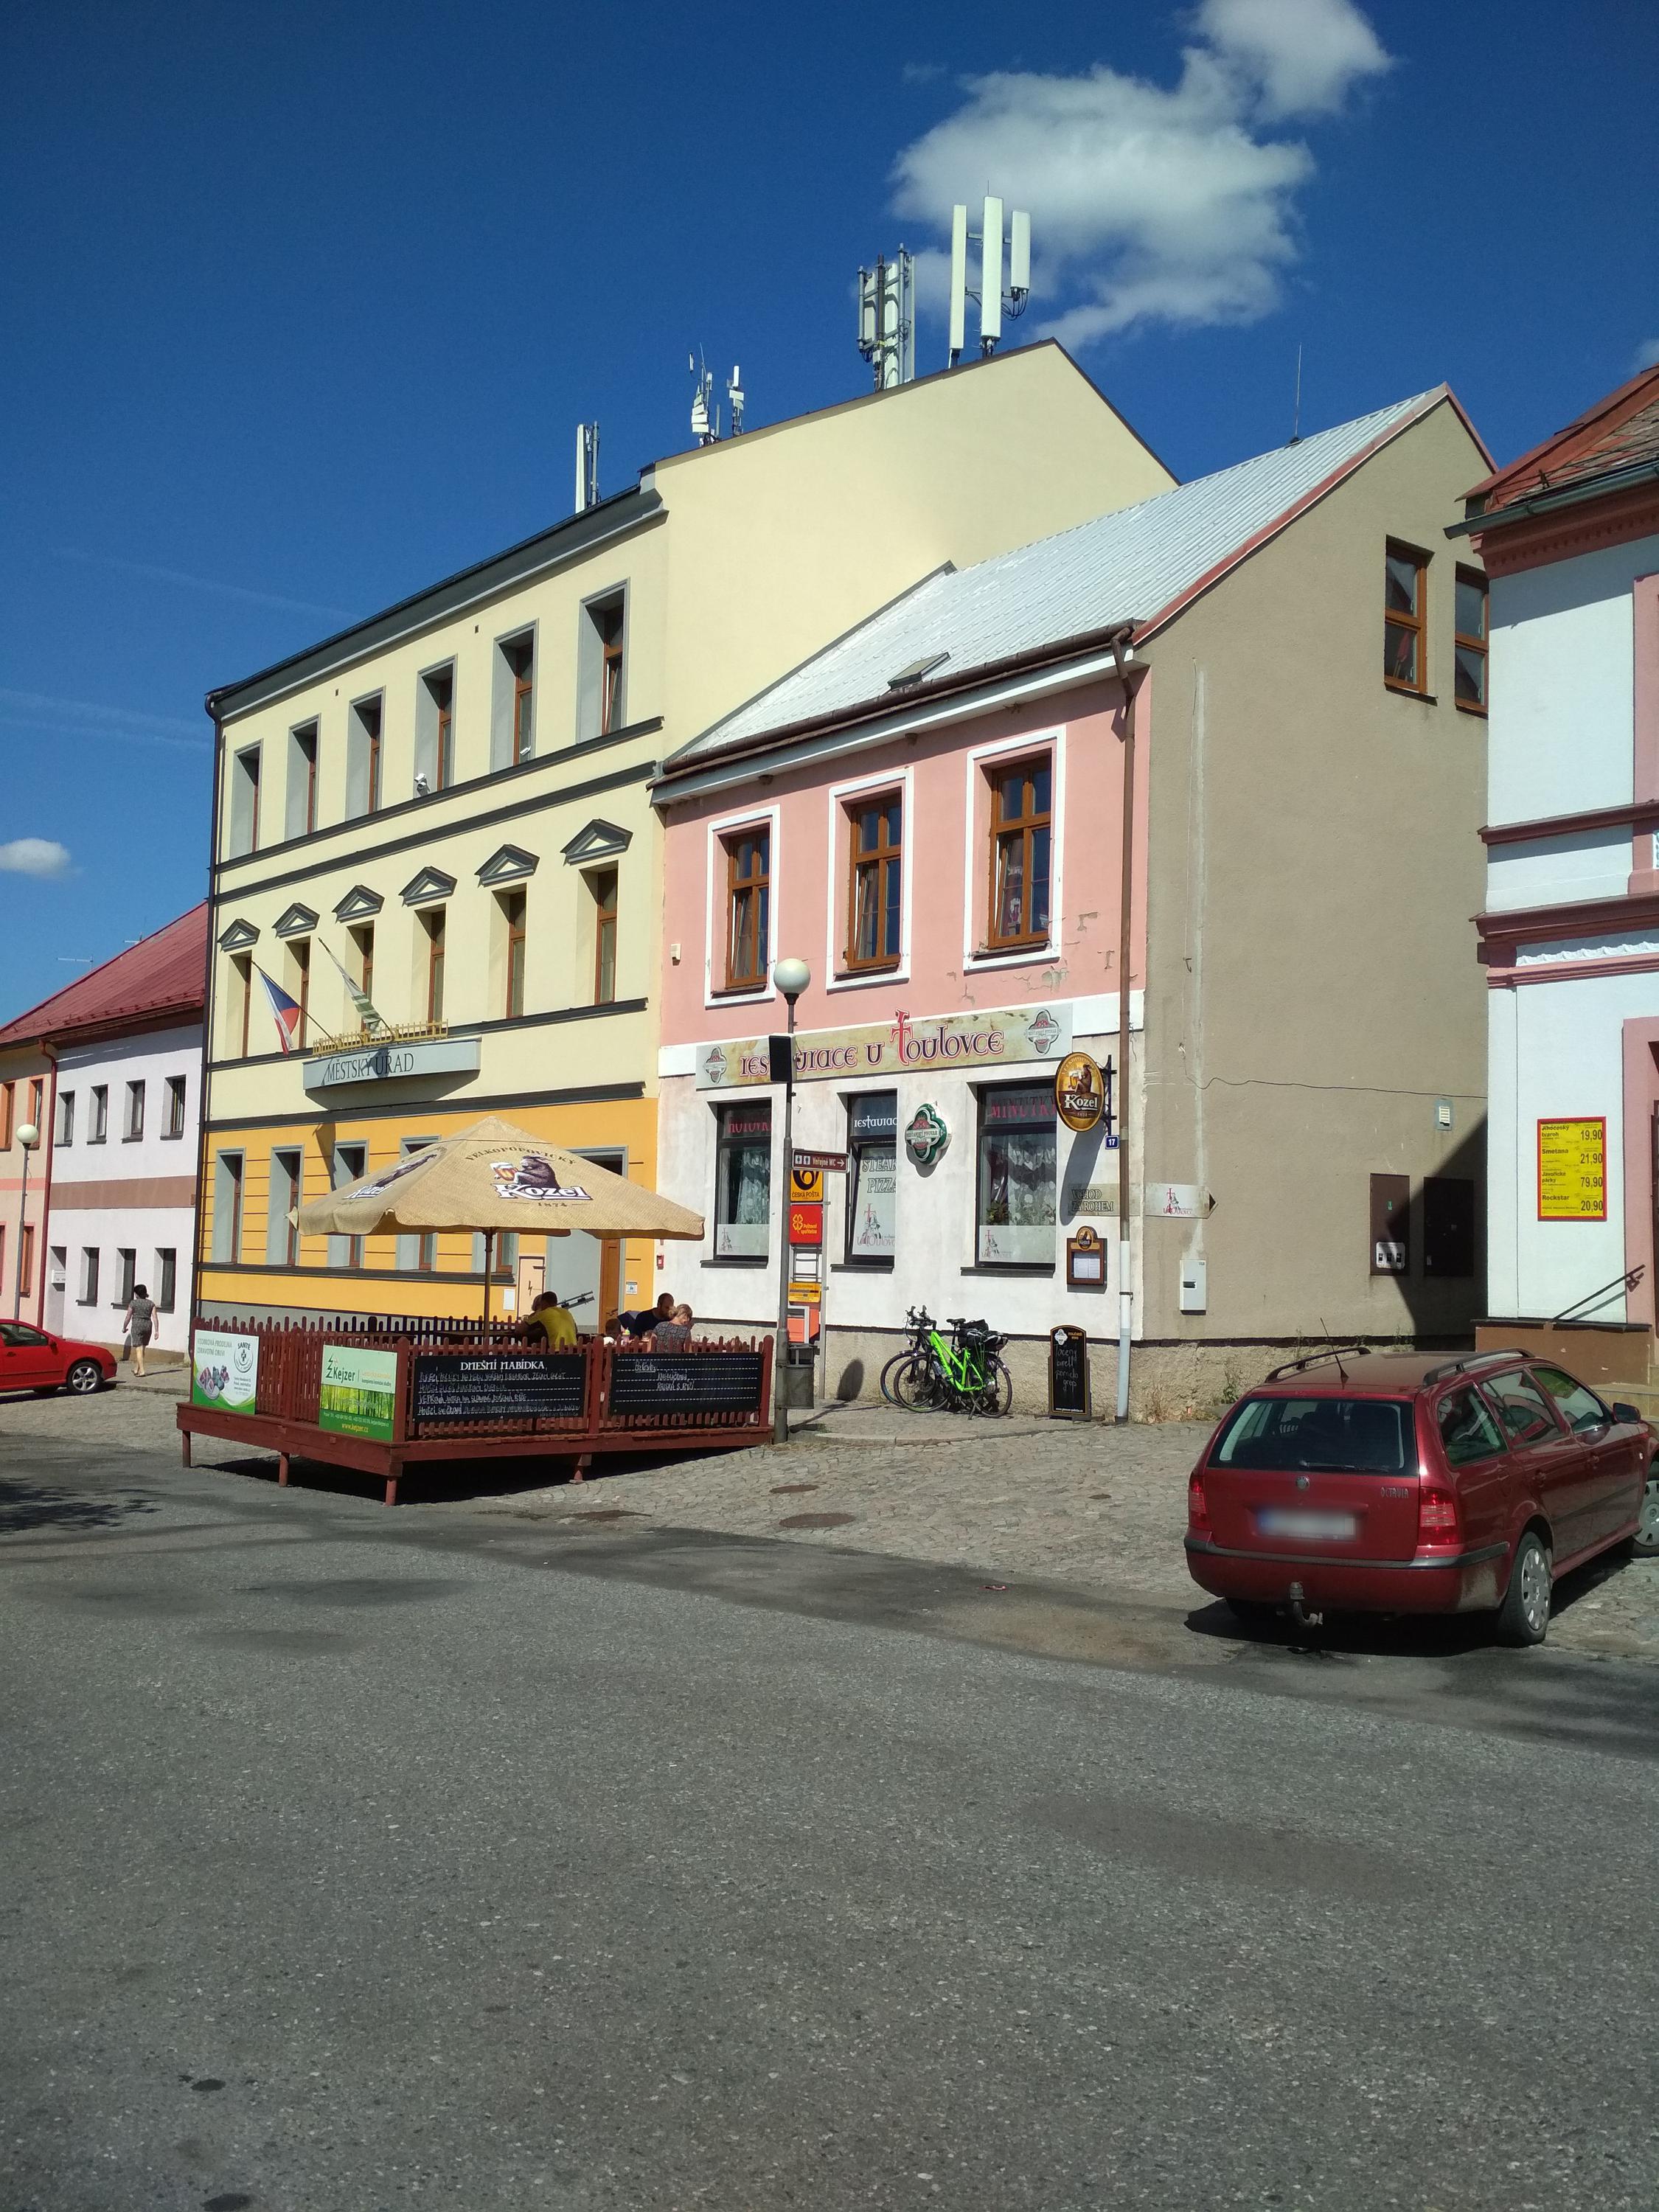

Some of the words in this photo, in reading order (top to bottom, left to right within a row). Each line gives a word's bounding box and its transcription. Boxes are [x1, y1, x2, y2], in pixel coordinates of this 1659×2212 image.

[327, 1054, 372, 1082] MĚSTSKÝ
[1064, 1094, 1098, 1110] Kozel
[1580, 1130, 1603, 1141] 19,90
[812, 1156, 828, 1167] Veřejné
[829, 1158, 836, 1166] WC
[1580, 1153, 1603, 1165] 21,90
[1580, 1177, 1603, 1189] 79,90
[490, 1183, 594, 1201] Kozel
[1071, 1189, 1102, 1200] VCHOD
[1071, 1201, 1082, 1211] ZA
[1083, 1201, 1114, 1211] ROHEM
[1581, 1200, 1604, 1212] 20,90
[461, 1359, 497, 1371] DNEŠNÍ
[500, 1358, 545, 1370] NABÍDKA
[333, 1367, 355, 1383] Kejzer
[341, 1423, 369, 1433] www.kejzer.cz
[1380, 1486, 1409, 1499] OCTAVIA
